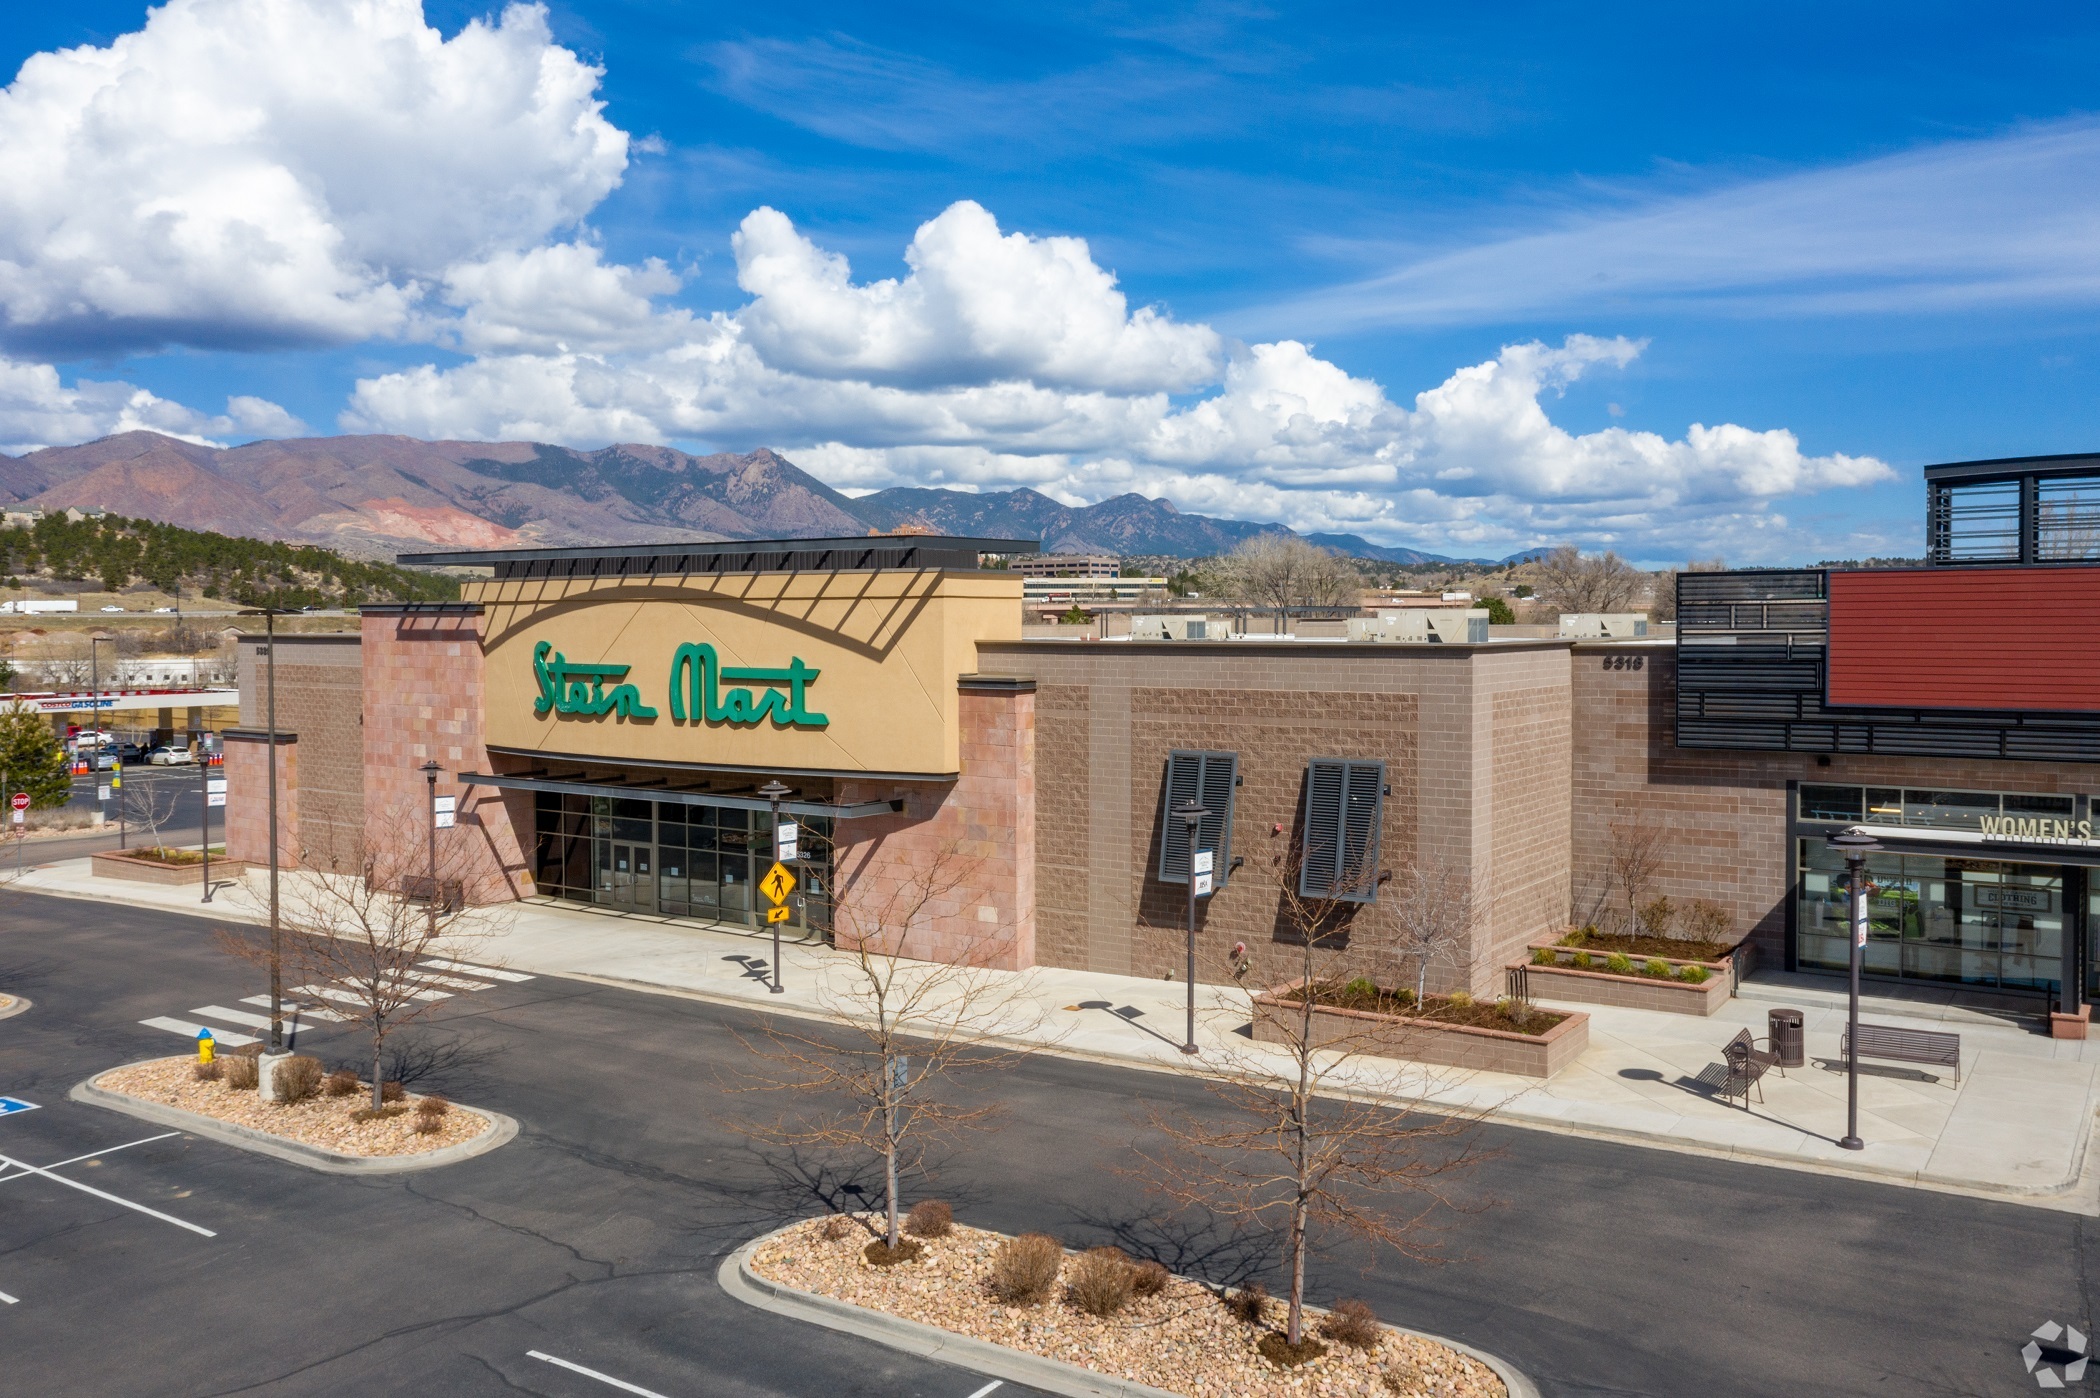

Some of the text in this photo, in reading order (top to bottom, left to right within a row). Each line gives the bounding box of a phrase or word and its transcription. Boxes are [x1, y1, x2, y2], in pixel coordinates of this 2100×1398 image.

[533, 641, 831, 727] Stein Mart
[41, 701, 71, 709] COSTCO
[13, 797, 29, 806] STOP
[1979, 815, 2091, 842] WOMEN'S
